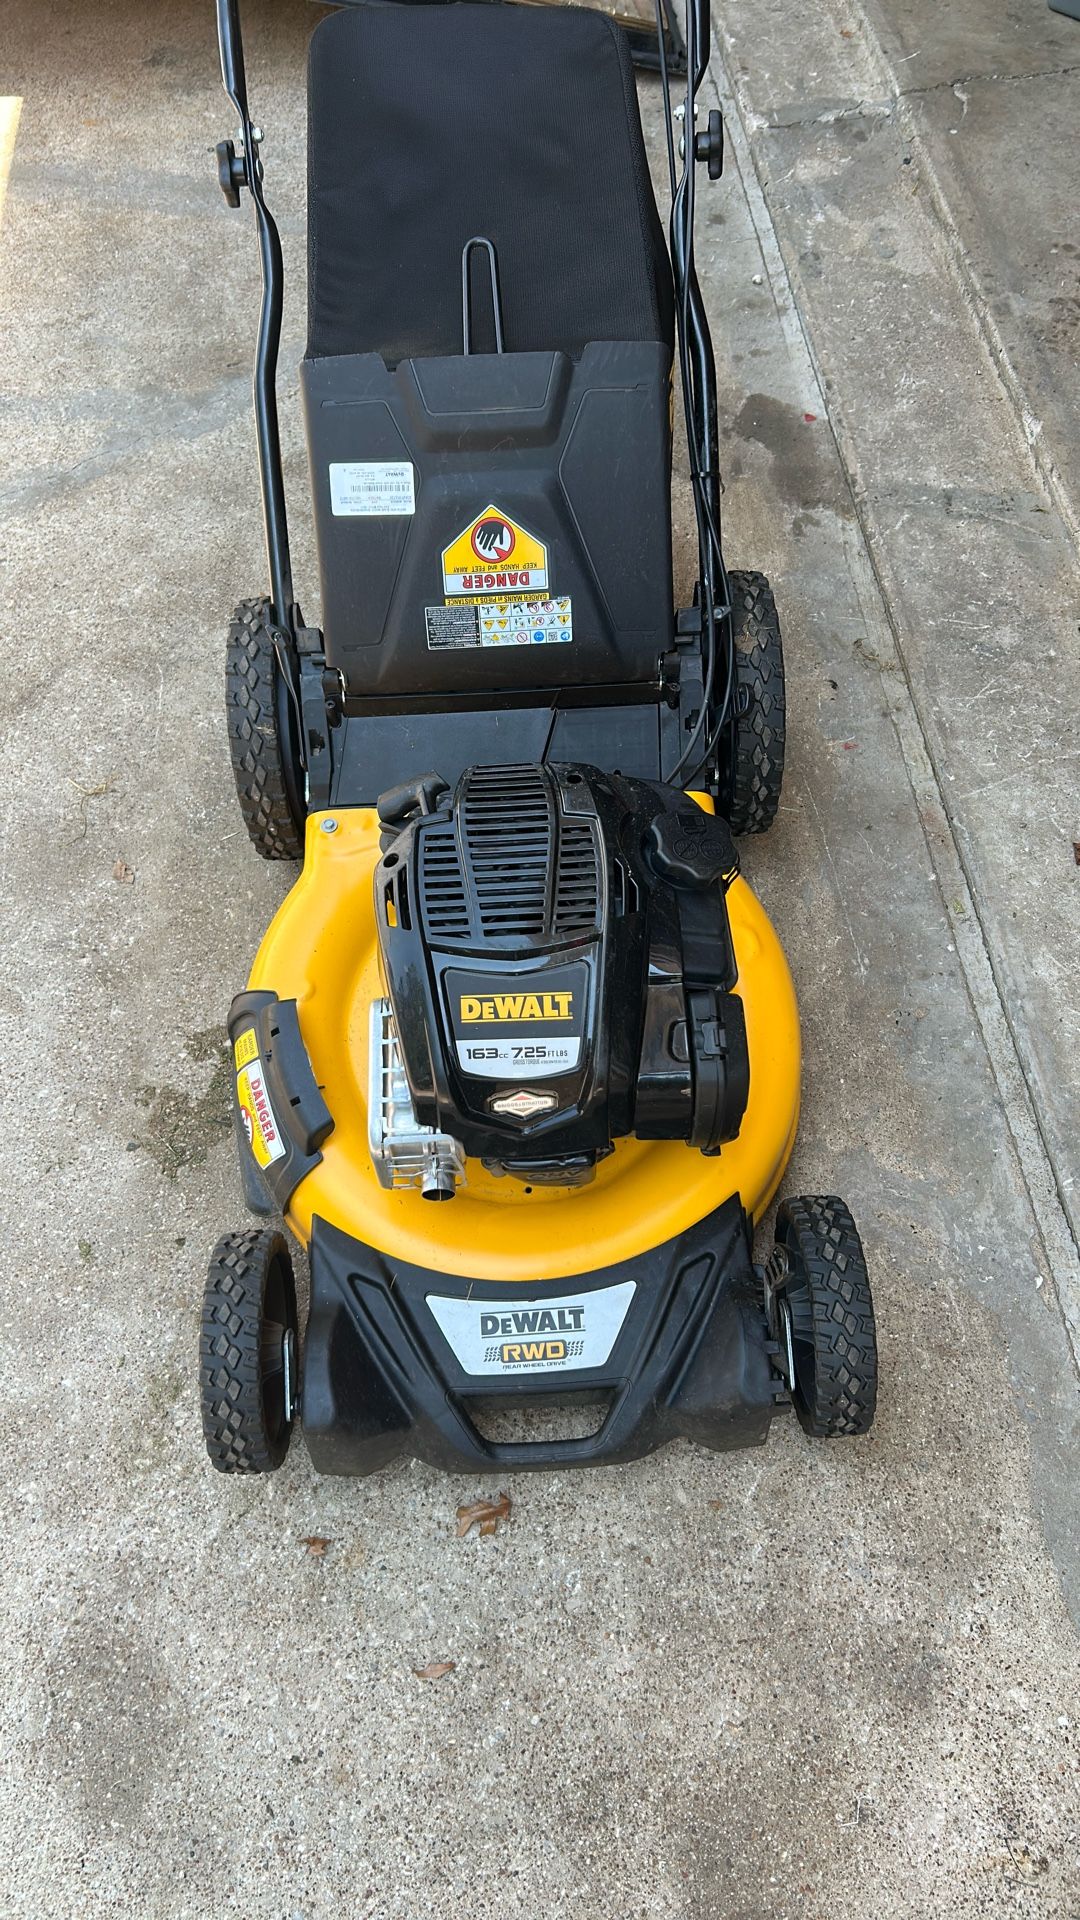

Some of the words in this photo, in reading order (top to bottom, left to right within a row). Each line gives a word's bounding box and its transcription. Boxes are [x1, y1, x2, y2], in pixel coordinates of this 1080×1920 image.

[471, 565, 485, 573] FEET
[500, 563, 520, 571] HANDS
[462, 571, 530, 589] DANGER
[504, 595, 522, 603] MAINS
[523, 593, 548, 601] GARDER
[511, 1046, 547, 1059] 7.25
[251, 1078, 276, 1143] DANGER
[503, 1341, 564, 1361] RWD
[502, 1363, 522, 1371] REAR
[523, 1361, 546, 1369] WHEEL
